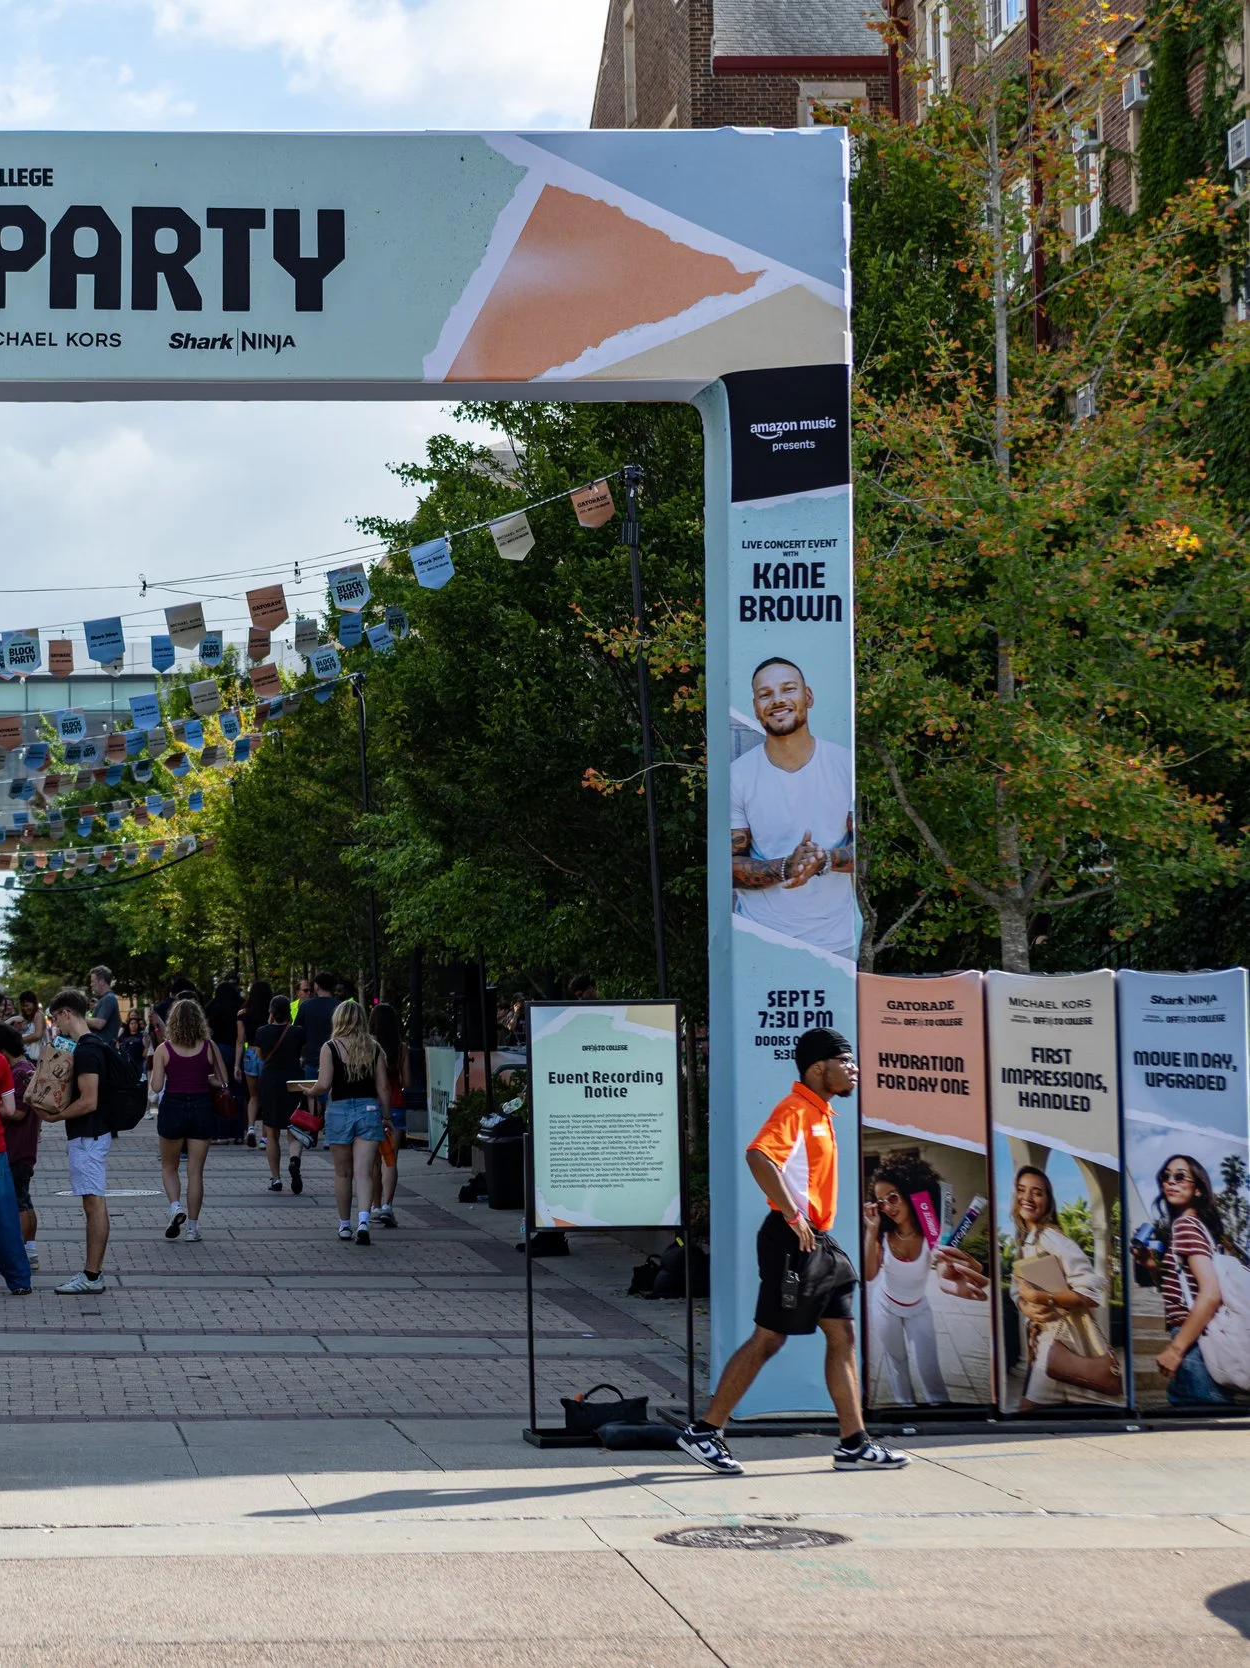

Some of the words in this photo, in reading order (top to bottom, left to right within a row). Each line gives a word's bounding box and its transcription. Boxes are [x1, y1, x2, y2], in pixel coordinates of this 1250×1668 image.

[67, 332, 122, 348] KORS
[170, 332, 235, 351] Shark
[241, 331, 296, 355] NINJA
[750, 420, 797, 438] amazon
[799, 417, 837, 431] music
[772, 439, 816, 451] presents
[742, 540, 763, 550] LIVE
[764, 539, 807, 550] CONCERT
[808, 538, 838, 549] EVENT
[753, 562, 826, 590] KANE
[336, 580, 363, 595] BLOCK
[338, 589, 365, 602] PARTY
[739, 594, 842, 622] BROWN
[9, 646, 35, 657] BLOCK
[9, 655, 37, 665] PARTY
[767, 989, 810, 1008] SEPT
[814, 989, 825, 1007] 5
[886, 1000, 954, 1011] GATORADE
[1009, 997, 1060, 1009] MICHAEL
[1062, 998, 1092, 1009] KORS
[1150, 995, 1184, 1005] Shark
[758, 1010, 799, 1028] 7:30
[804, 1010, 833, 1028] PM
[904, 1018, 918, 1026] OFF
[935, 1017, 963, 1026] COLLEGE
[755, 1035, 790, 1046] DOORS
[878, 1052, 965, 1073] HYDRATION
[1031, 1047, 1072, 1065] FIRST
[1183, 1052, 1199, 1068] IN
[1200, 1053, 1238, 1072] DAY,
[548, 1071, 589, 1085] Event
[592, 1070, 663, 1085] Recording
[877, 1073, 906, 1091] FOR
[907, 1075, 938, 1093] DAY
[940, 1077, 970, 1096] ONE
[1001, 1067, 1108, 1094] IMPRESSIONS,
[1144, 1072, 1226, 1091] UPGRADED
[584, 1085, 628, 1099] Notice
[1018, 1091, 1091, 1112] HANDLED
